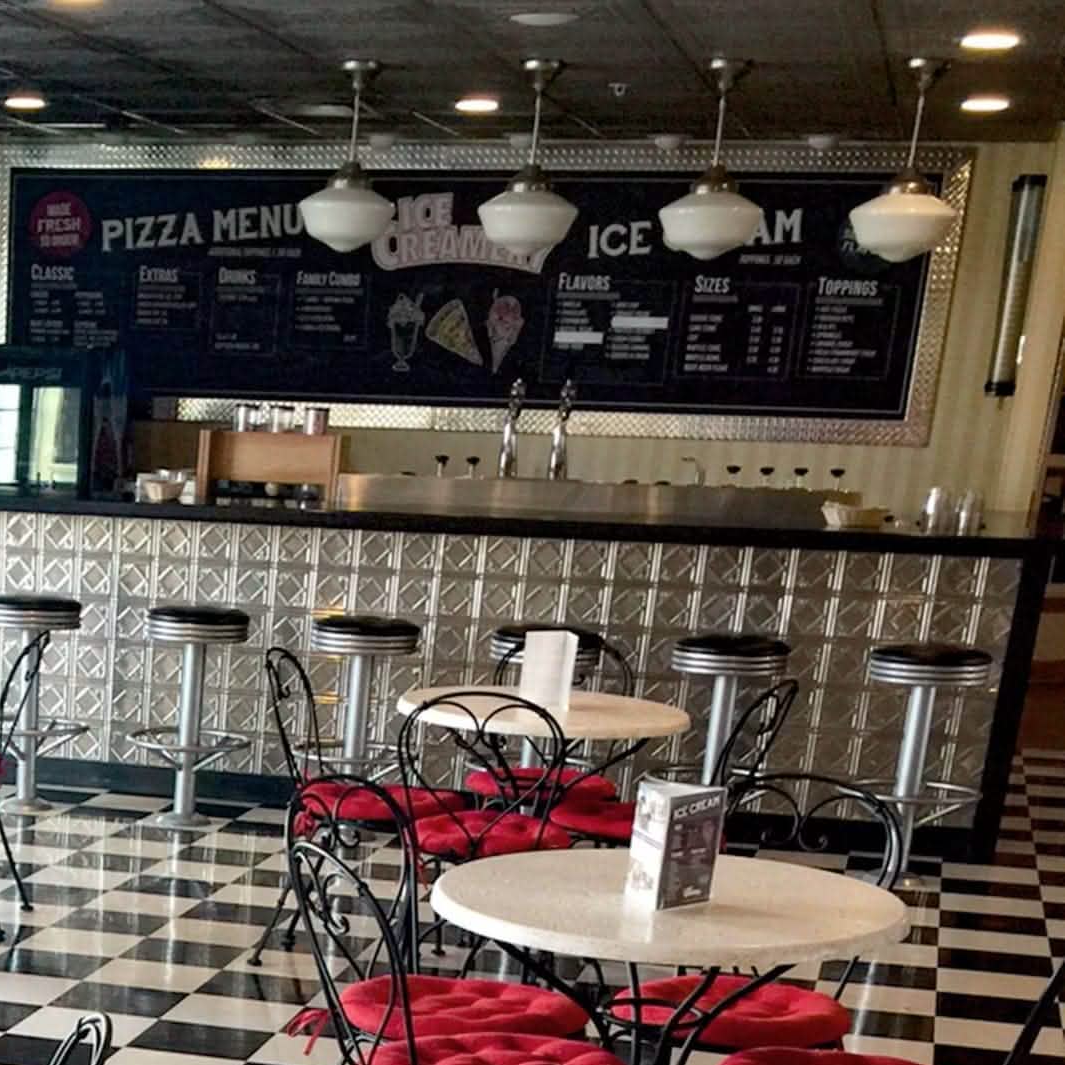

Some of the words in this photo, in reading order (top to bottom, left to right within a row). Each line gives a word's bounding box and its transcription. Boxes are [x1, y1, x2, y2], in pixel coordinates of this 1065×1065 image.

[398, 192, 454, 232] ICE
[37, 217, 81, 233] FRESH
[101, 212, 204, 252] PIZZA
[212, 203, 304, 243] MENU
[372, 227, 549, 272] CREAMY
[587, 220, 652, 259] ICE
[30, 263, 75, 281] CLASSIC
[138, 264, 179, 283] EXTRAS
[558, 271, 611, 291] FLAVORS
[694, 274, 731, 294] SIZES
[817, 275, 879, 297] TOPPINGS
